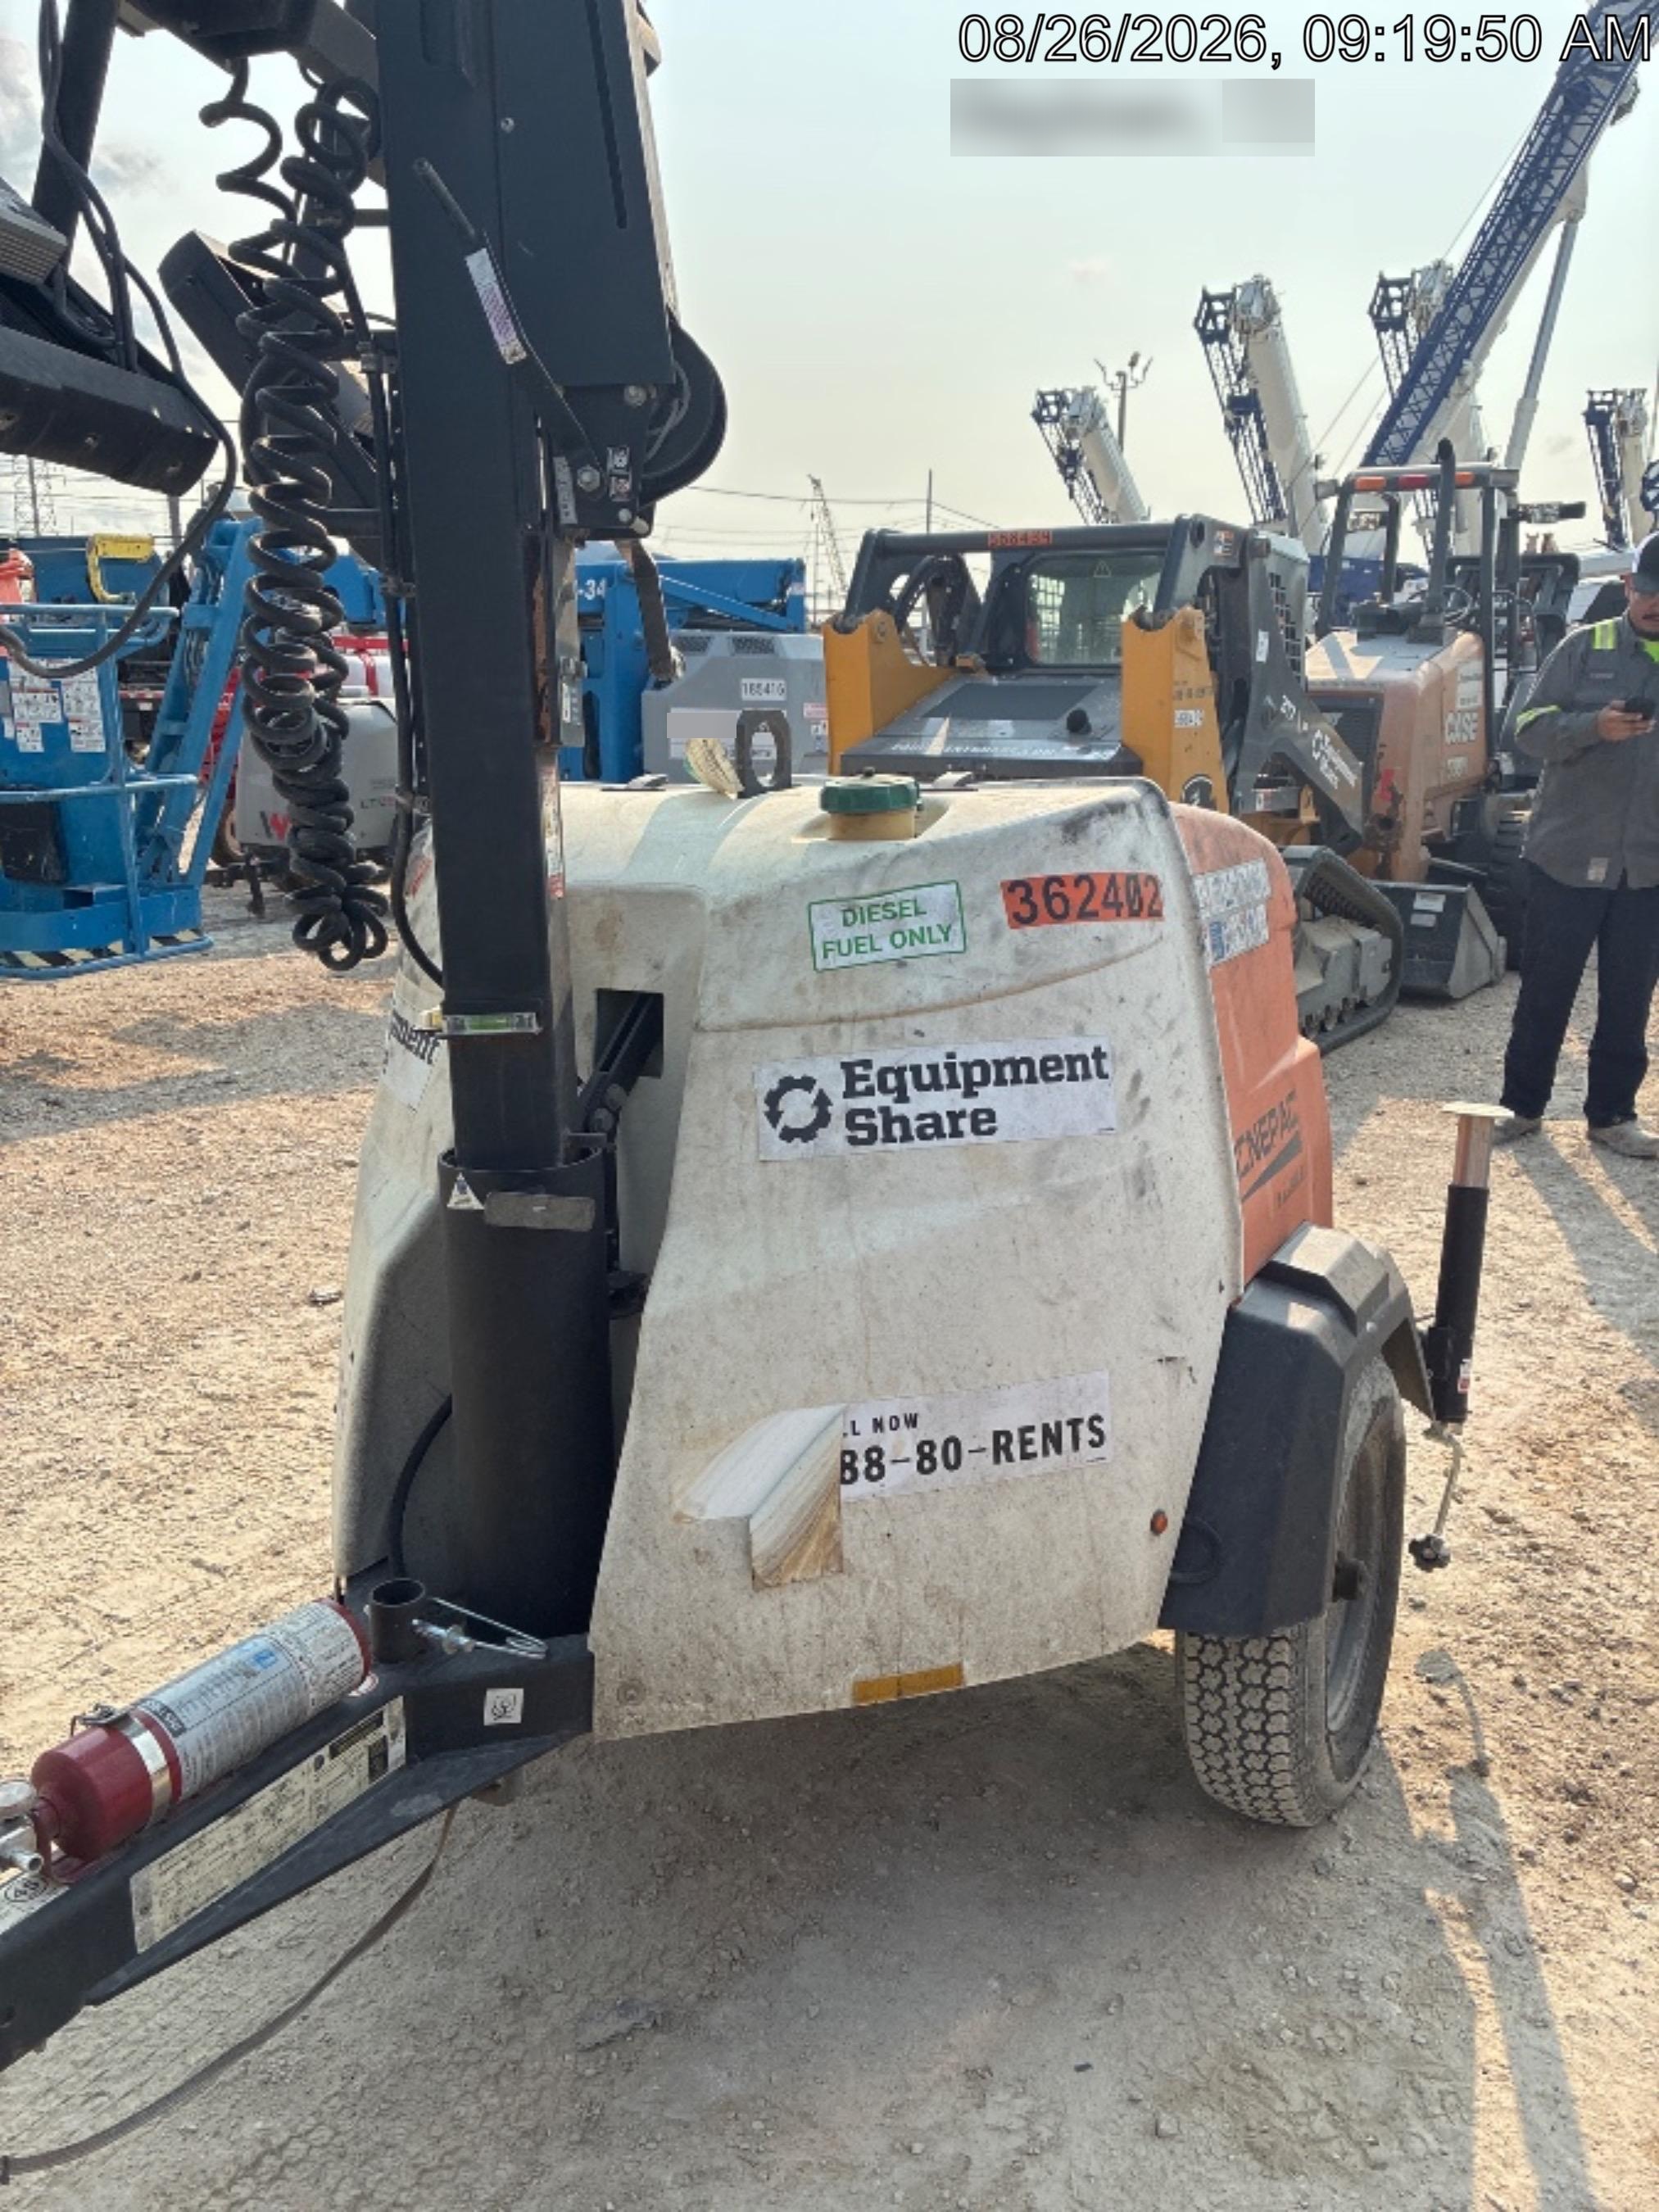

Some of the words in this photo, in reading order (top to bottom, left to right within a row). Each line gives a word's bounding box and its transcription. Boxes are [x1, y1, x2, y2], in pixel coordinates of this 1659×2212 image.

[841, 896, 927, 927] DIESEL
[1007, 874, 1163, 925] 362402
[823, 932, 882, 959] FUEL
[889, 922, 953, 950] ONLY
[841, 1045, 1109, 1104] Equipment
[845, 1106, 998, 1145] Share
[843, 1420, 860, 1437] L
[873, 1412, 918, 1434] NOW
